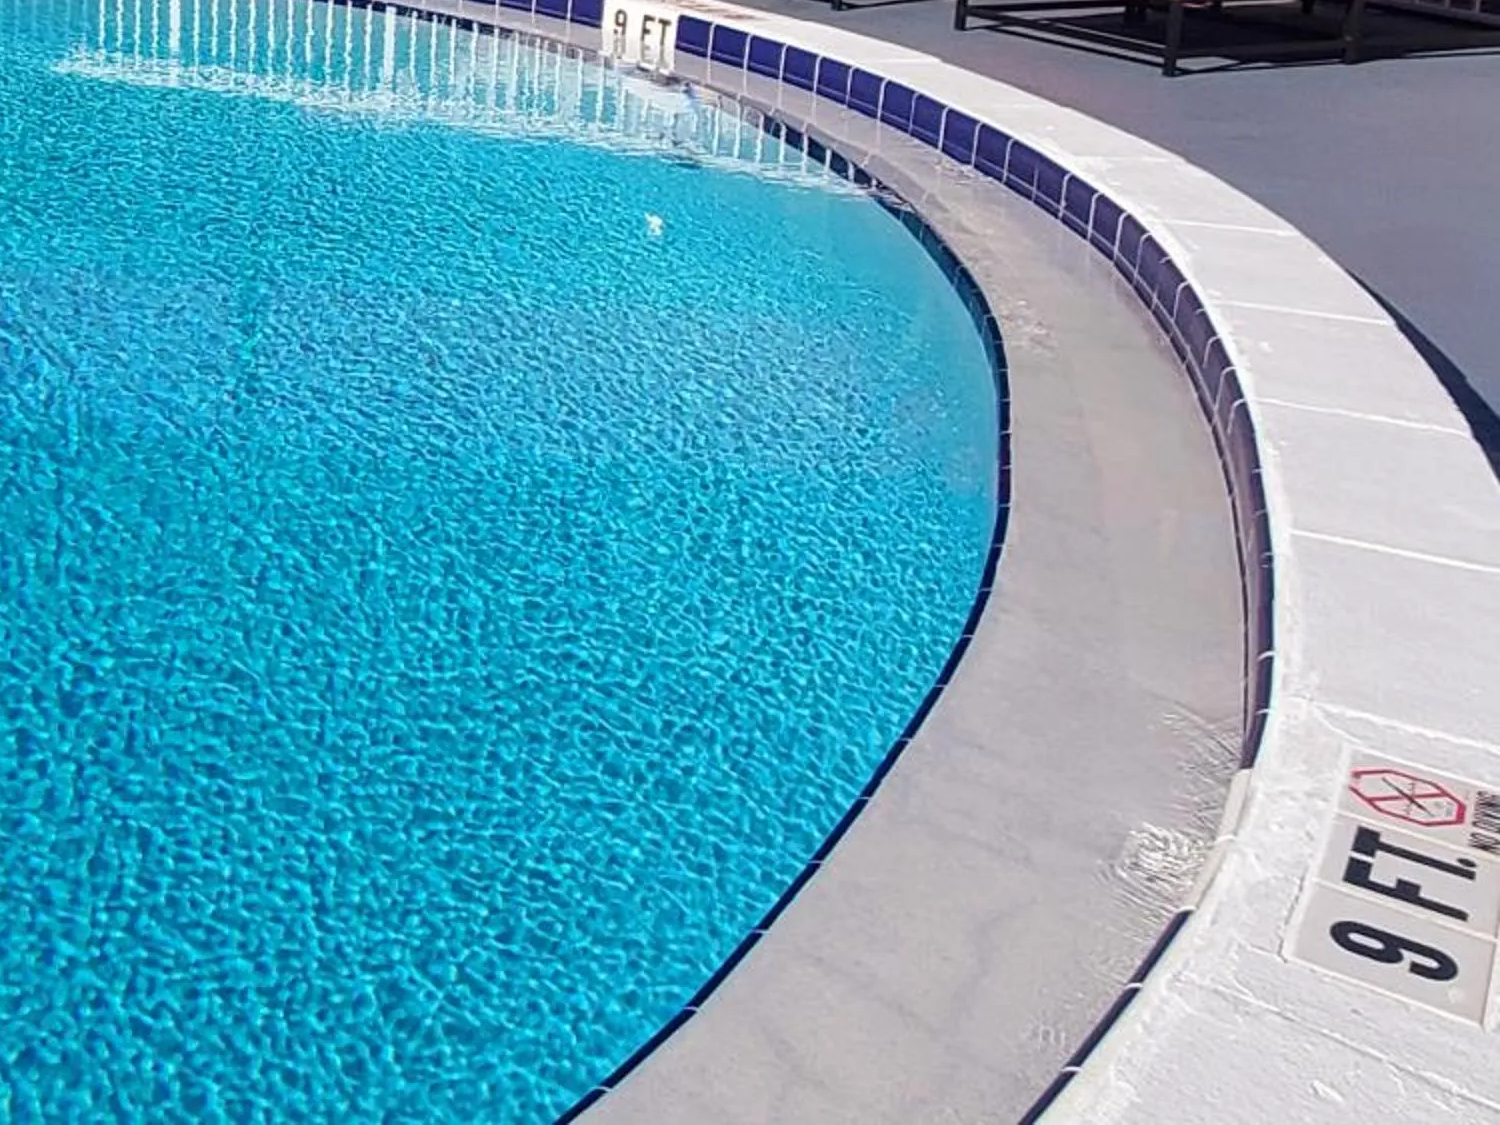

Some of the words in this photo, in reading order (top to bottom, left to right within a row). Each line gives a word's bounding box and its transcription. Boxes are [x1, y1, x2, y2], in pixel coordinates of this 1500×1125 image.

[613, 8, 627, 36] 9
[641, 14, 672, 46] FT
[1342, 825, 1478, 922] FT.
[1329, 920, 1459, 982] 9
